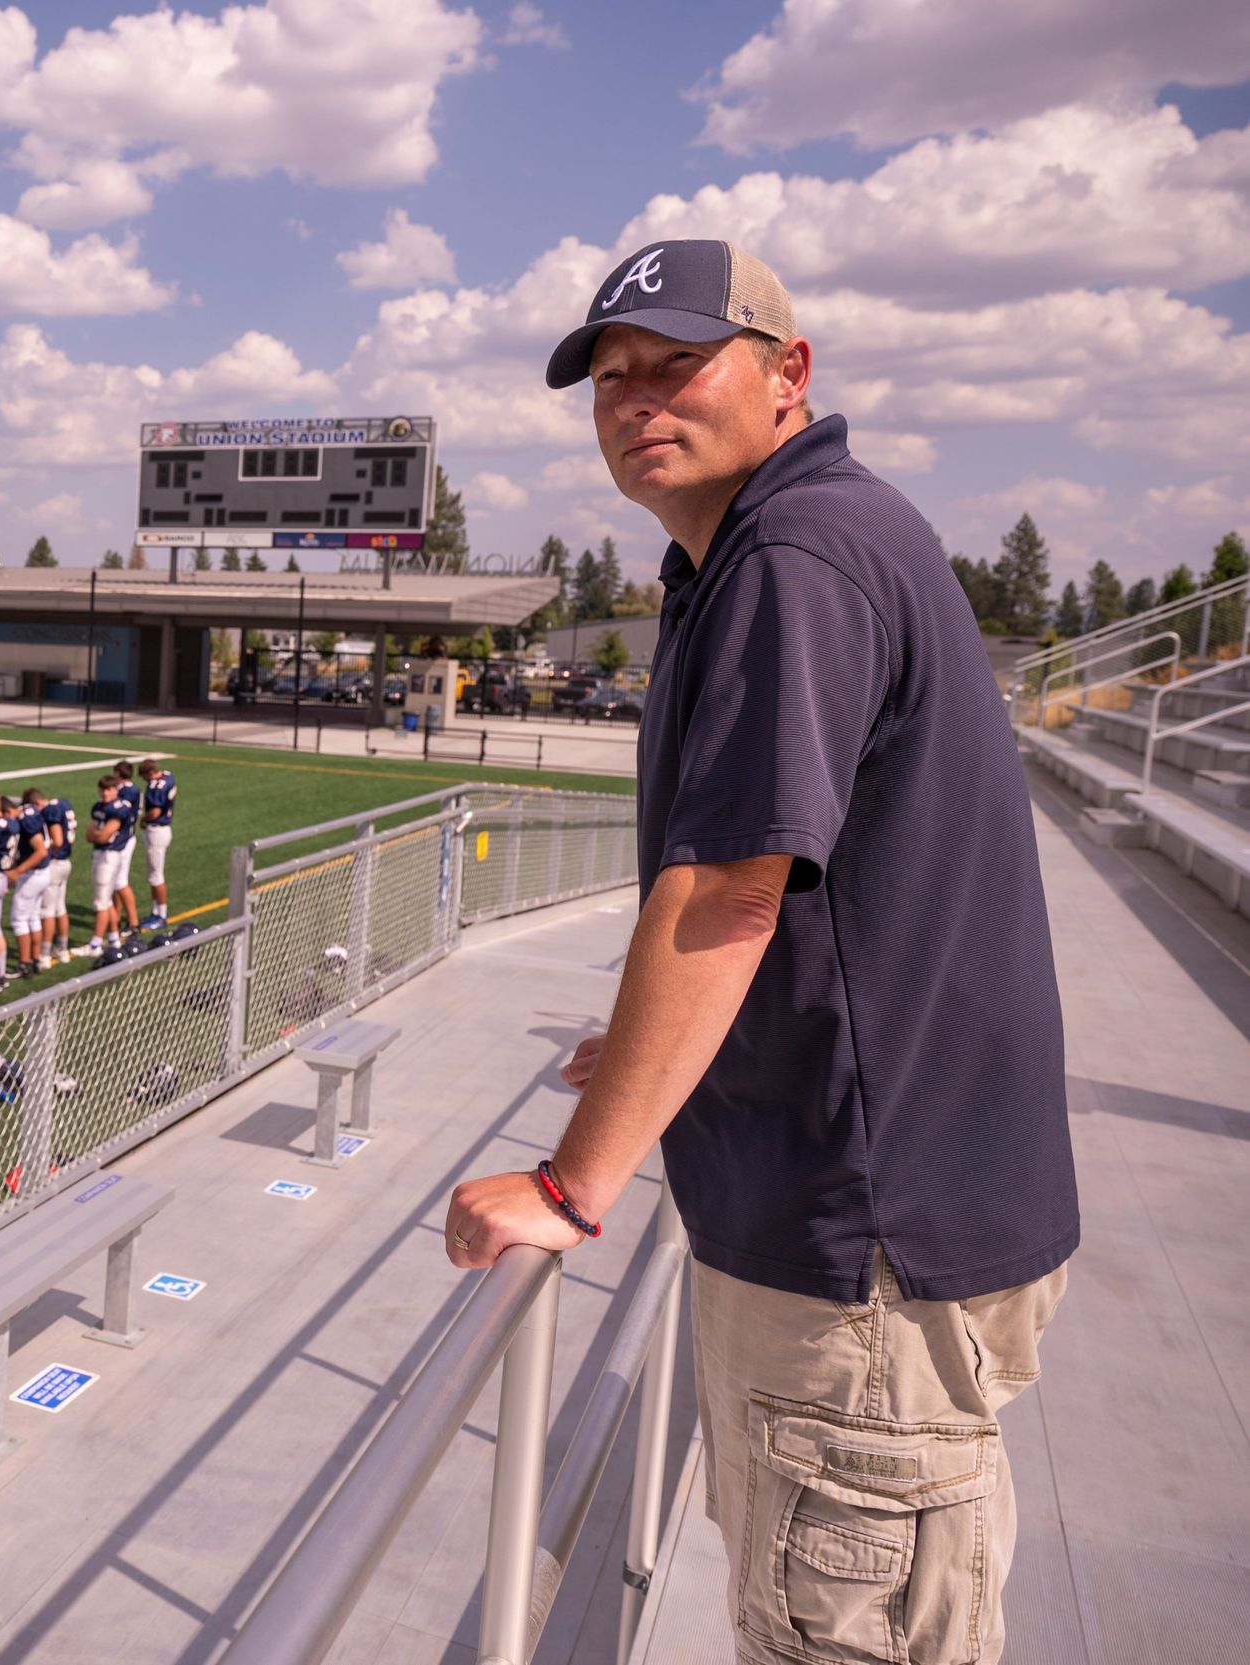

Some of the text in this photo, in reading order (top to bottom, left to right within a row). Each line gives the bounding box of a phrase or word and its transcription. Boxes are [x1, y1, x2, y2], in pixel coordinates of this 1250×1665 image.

[601, 248, 664, 311] A
[227, 417, 335, 429] WELCOME TO
[198, 431, 366, 445] UNION STADIUM
